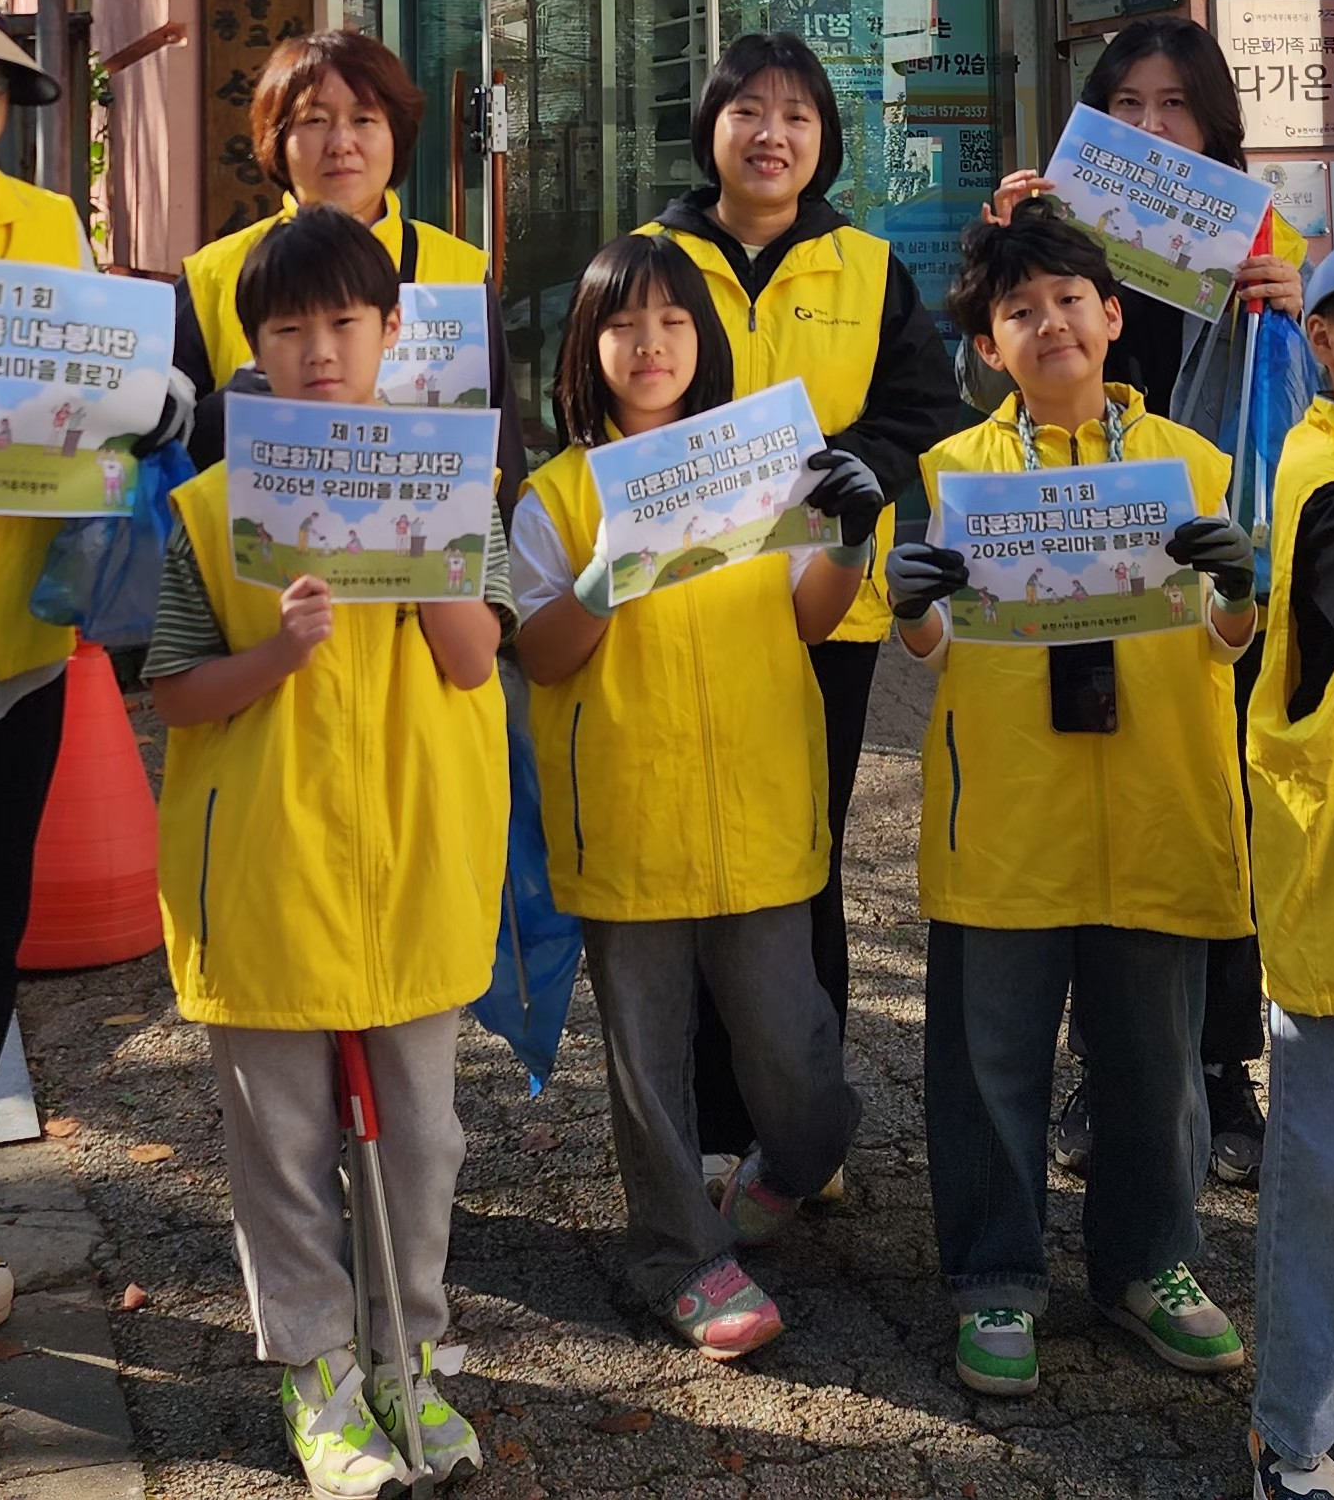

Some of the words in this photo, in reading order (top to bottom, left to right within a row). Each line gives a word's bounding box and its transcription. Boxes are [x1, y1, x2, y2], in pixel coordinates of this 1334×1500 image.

[1232, 36, 1304, 54] 다문화가족
[1147, 150, 1163, 166] 제
[1166, 157, 1173, 171] 1
[1175, 162, 1191, 178] 회
[1080, 142, 1161, 189] 다문화가족
[1158, 177, 1237, 223] 나눔봉사단
[1073, 165, 1124, 195] 2026년
[1127, 188, 1180, 219] 우리마을
[1181, 212, 1221, 238] 플로깅
[12, 286, 22, 307] 1
[32, 287, 53, 309] 회
[11, 317, 138, 359] 나눔봉사단
[64, 361, 123, 390] 플로깅
[331, 423, 348, 441] 제
[357, 425, 364, 442] 1
[372, 424, 389, 443] 회
[688, 434, 704, 451] 제
[708, 431, 717, 446] 1
[721, 423, 736, 441] 회
[251, 440, 353, 472] 다문화가족
[356, 450, 463, 477] 나눔봉사단
[626, 454, 714, 503] 다문화가족
[716, 424, 799, 472] 나눔봉사단
[253, 472, 315, 496] 2026년
[322, 480, 392, 500] 우리마을
[399, 482, 450, 501] 플로깅
[633, 493, 692, 524] 2026년
[695, 471, 753, 502] 우리마을
[757, 453, 799, 481] 플로깅
[1040, 486, 1058, 503] 제
[1064, 486, 1072, 502] 1
[1079, 484, 1095, 502] 회
[967, 509, 1066, 537] 다문화가족
[1069, 501, 1167, 530] 나눔봉사단
[971, 541, 1036, 560] 2026년
[1041, 535, 1107, 553] 우리마을
[1113, 531, 1161, 549] 플로깅
